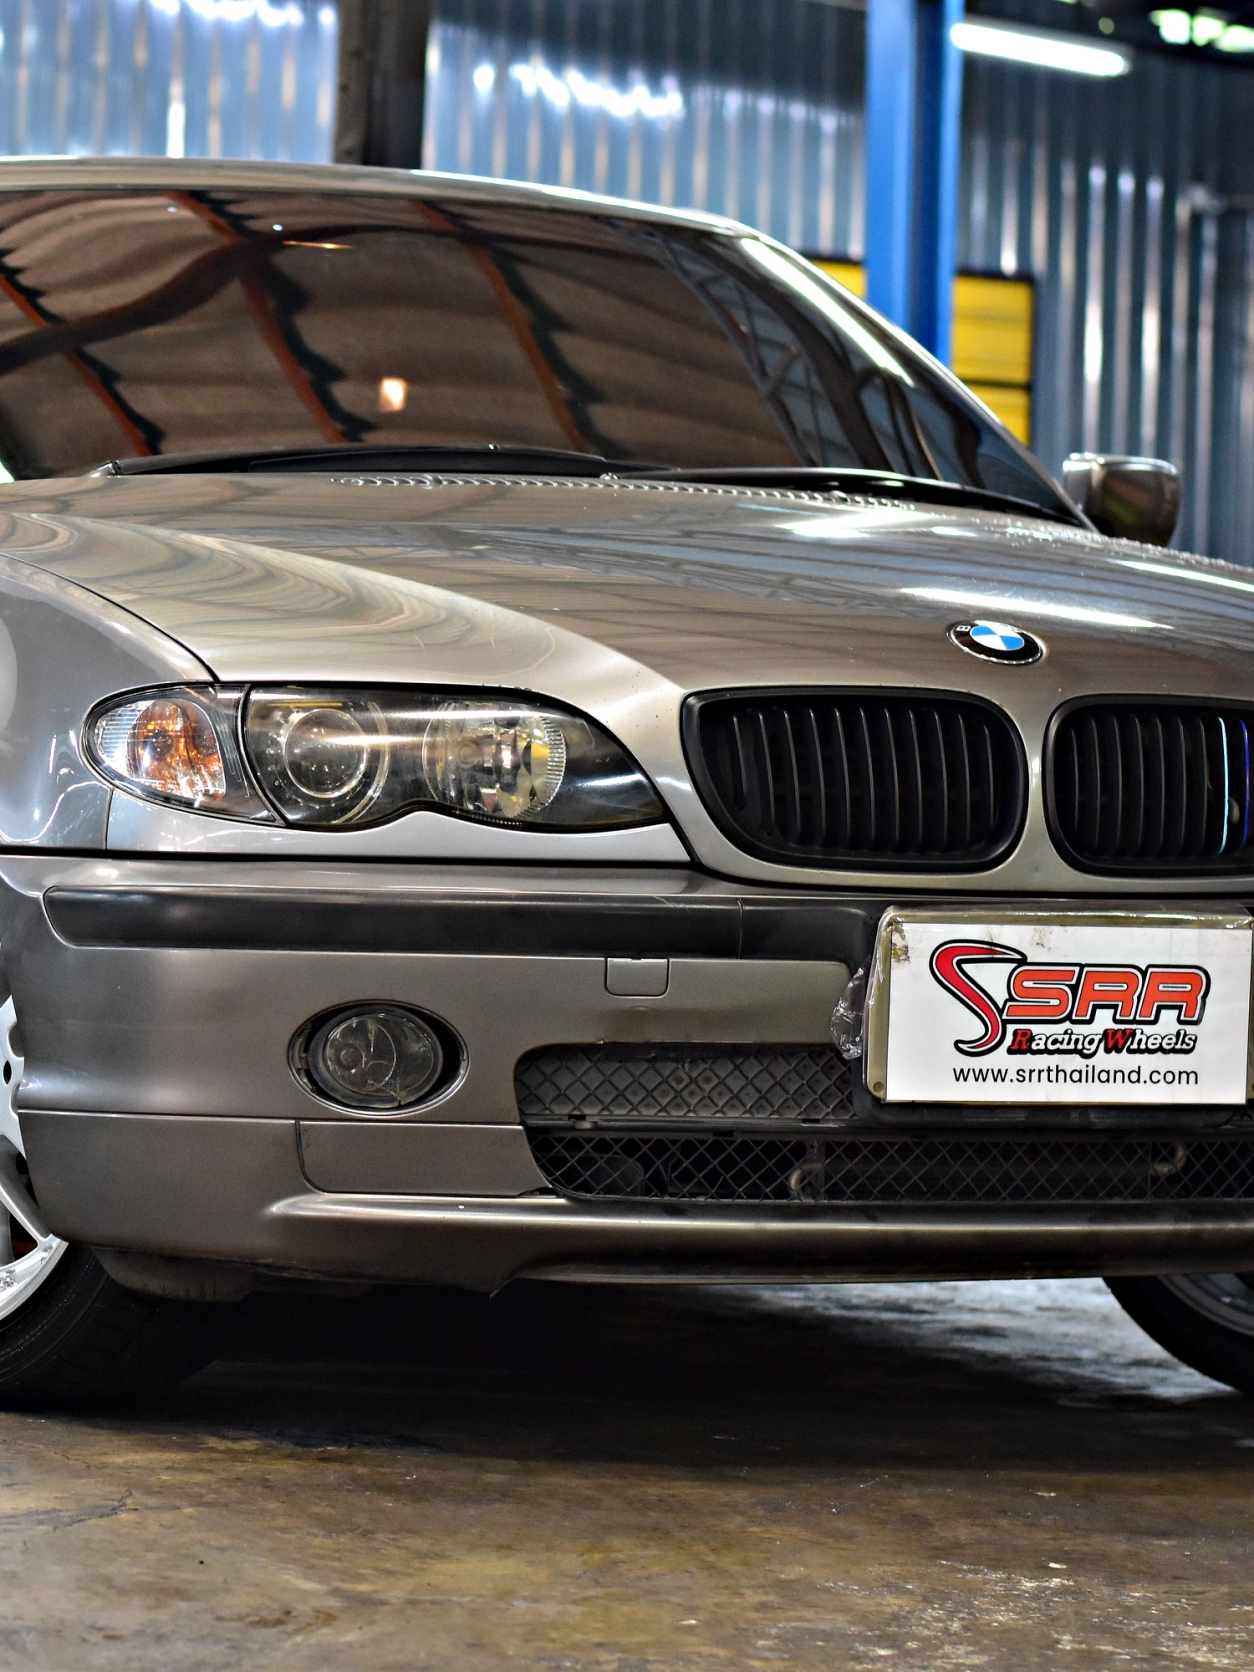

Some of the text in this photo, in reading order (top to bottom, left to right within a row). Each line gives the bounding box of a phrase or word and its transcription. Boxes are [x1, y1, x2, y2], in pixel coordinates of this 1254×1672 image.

[1010, 1028, 1197, 1055] Racing Wheels
[952, 1065, 1199, 1085] www.srrthailand.com
